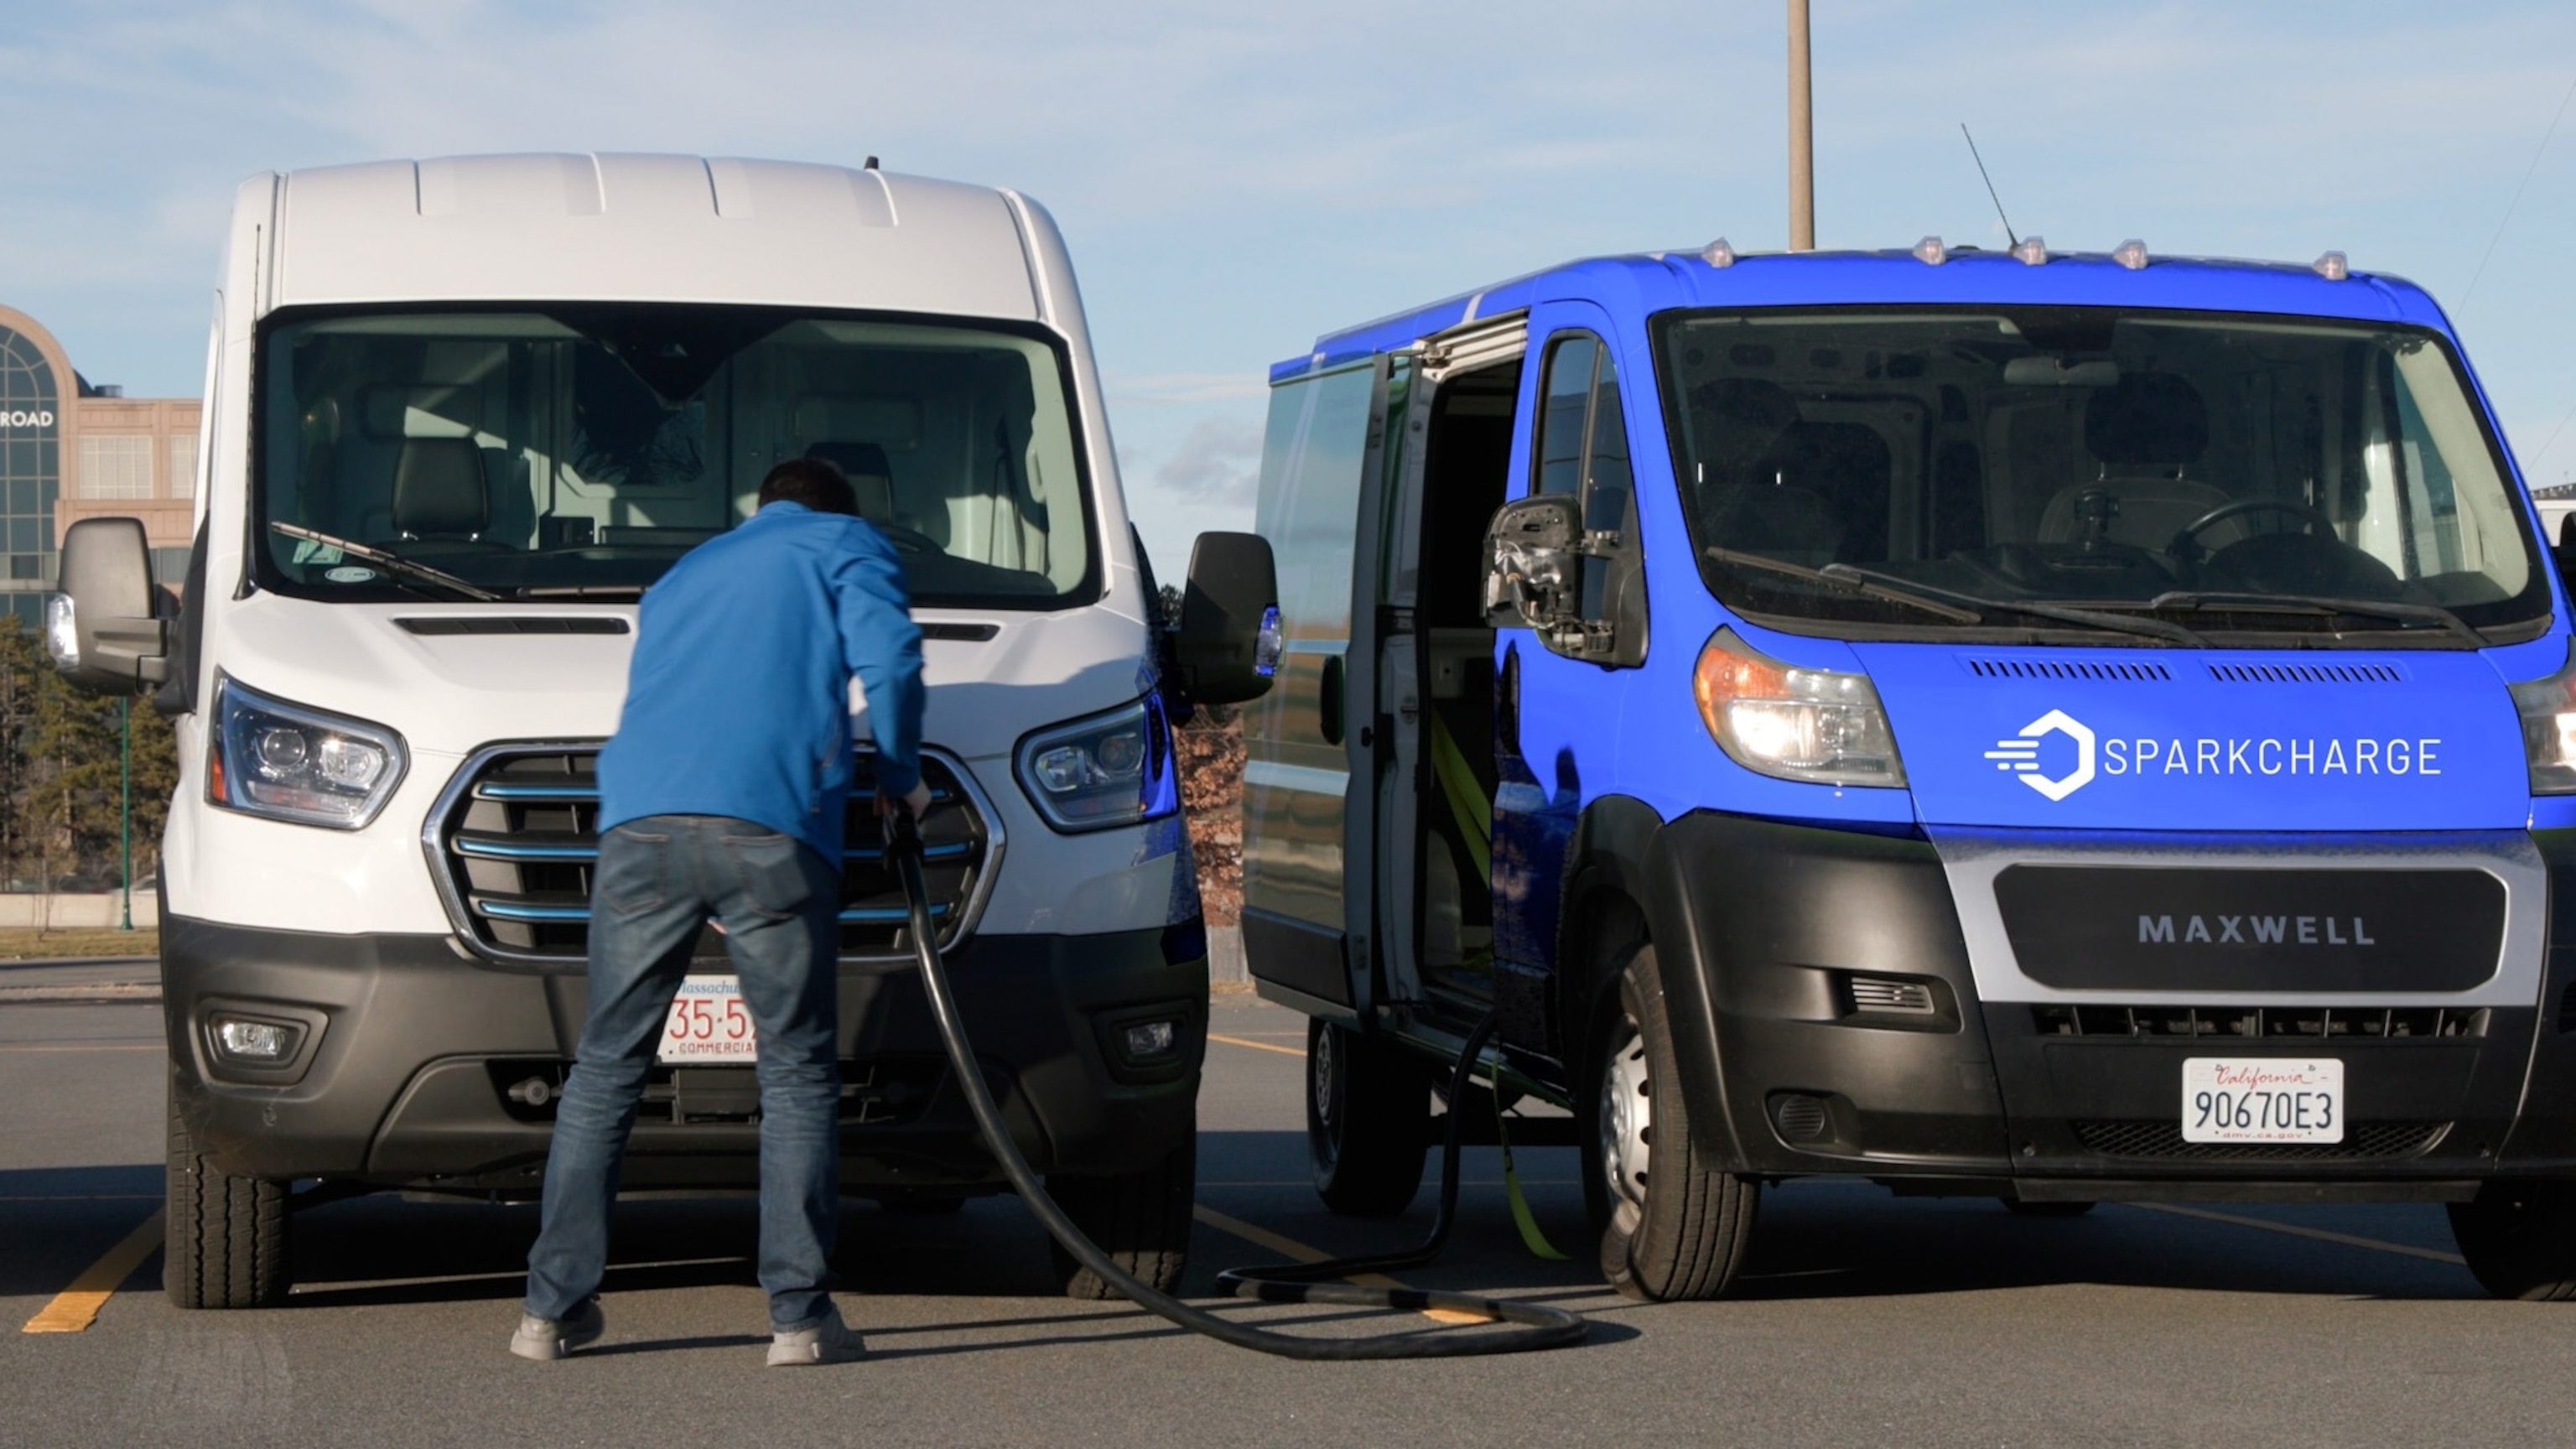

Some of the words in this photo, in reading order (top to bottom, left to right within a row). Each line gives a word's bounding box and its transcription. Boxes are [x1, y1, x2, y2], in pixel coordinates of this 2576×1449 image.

[0, 410, 54, 428] ROAD
[2104, 738, 2442, 776] SPARKCHARGE
[2138, 914, 2376, 946] MAXWELL
[2216, 1066, 2313, 1090] California
[2195, 1091, 2332, 1129] 90670E3
[2222, 1131, 2303, 1140] dmv.ca.gov
